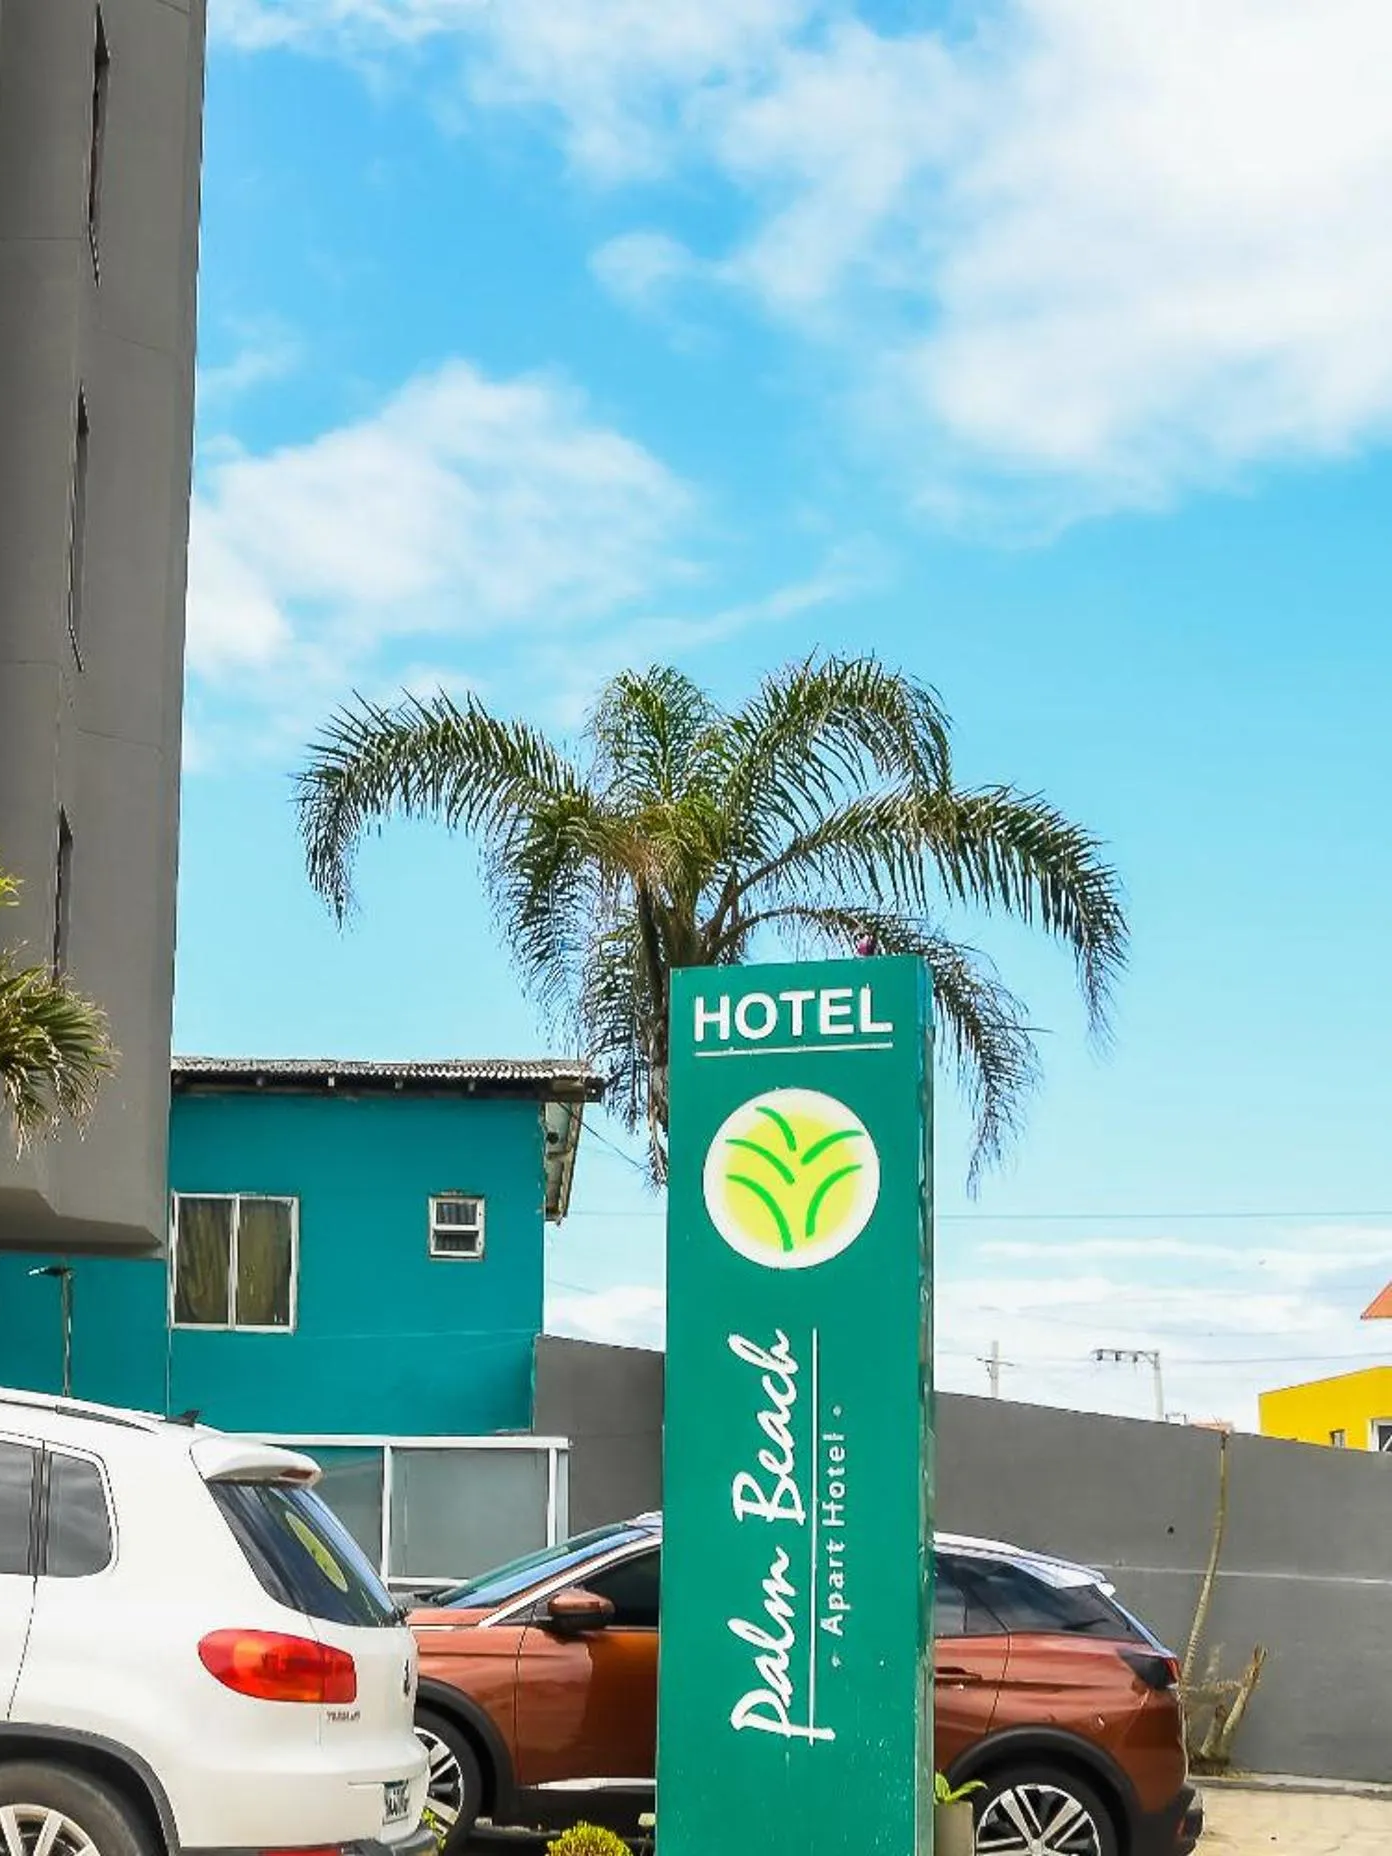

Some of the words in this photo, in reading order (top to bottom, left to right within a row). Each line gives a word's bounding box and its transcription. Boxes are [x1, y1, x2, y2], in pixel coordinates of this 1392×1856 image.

[694, 986, 893, 1042] HOTEL
[727, 1328, 806, 1526] Beach
[821, 1432, 846, 1527] Hotel
[820, 1539, 851, 1636] Apart
[727, 1546, 836, 1741] Palm
